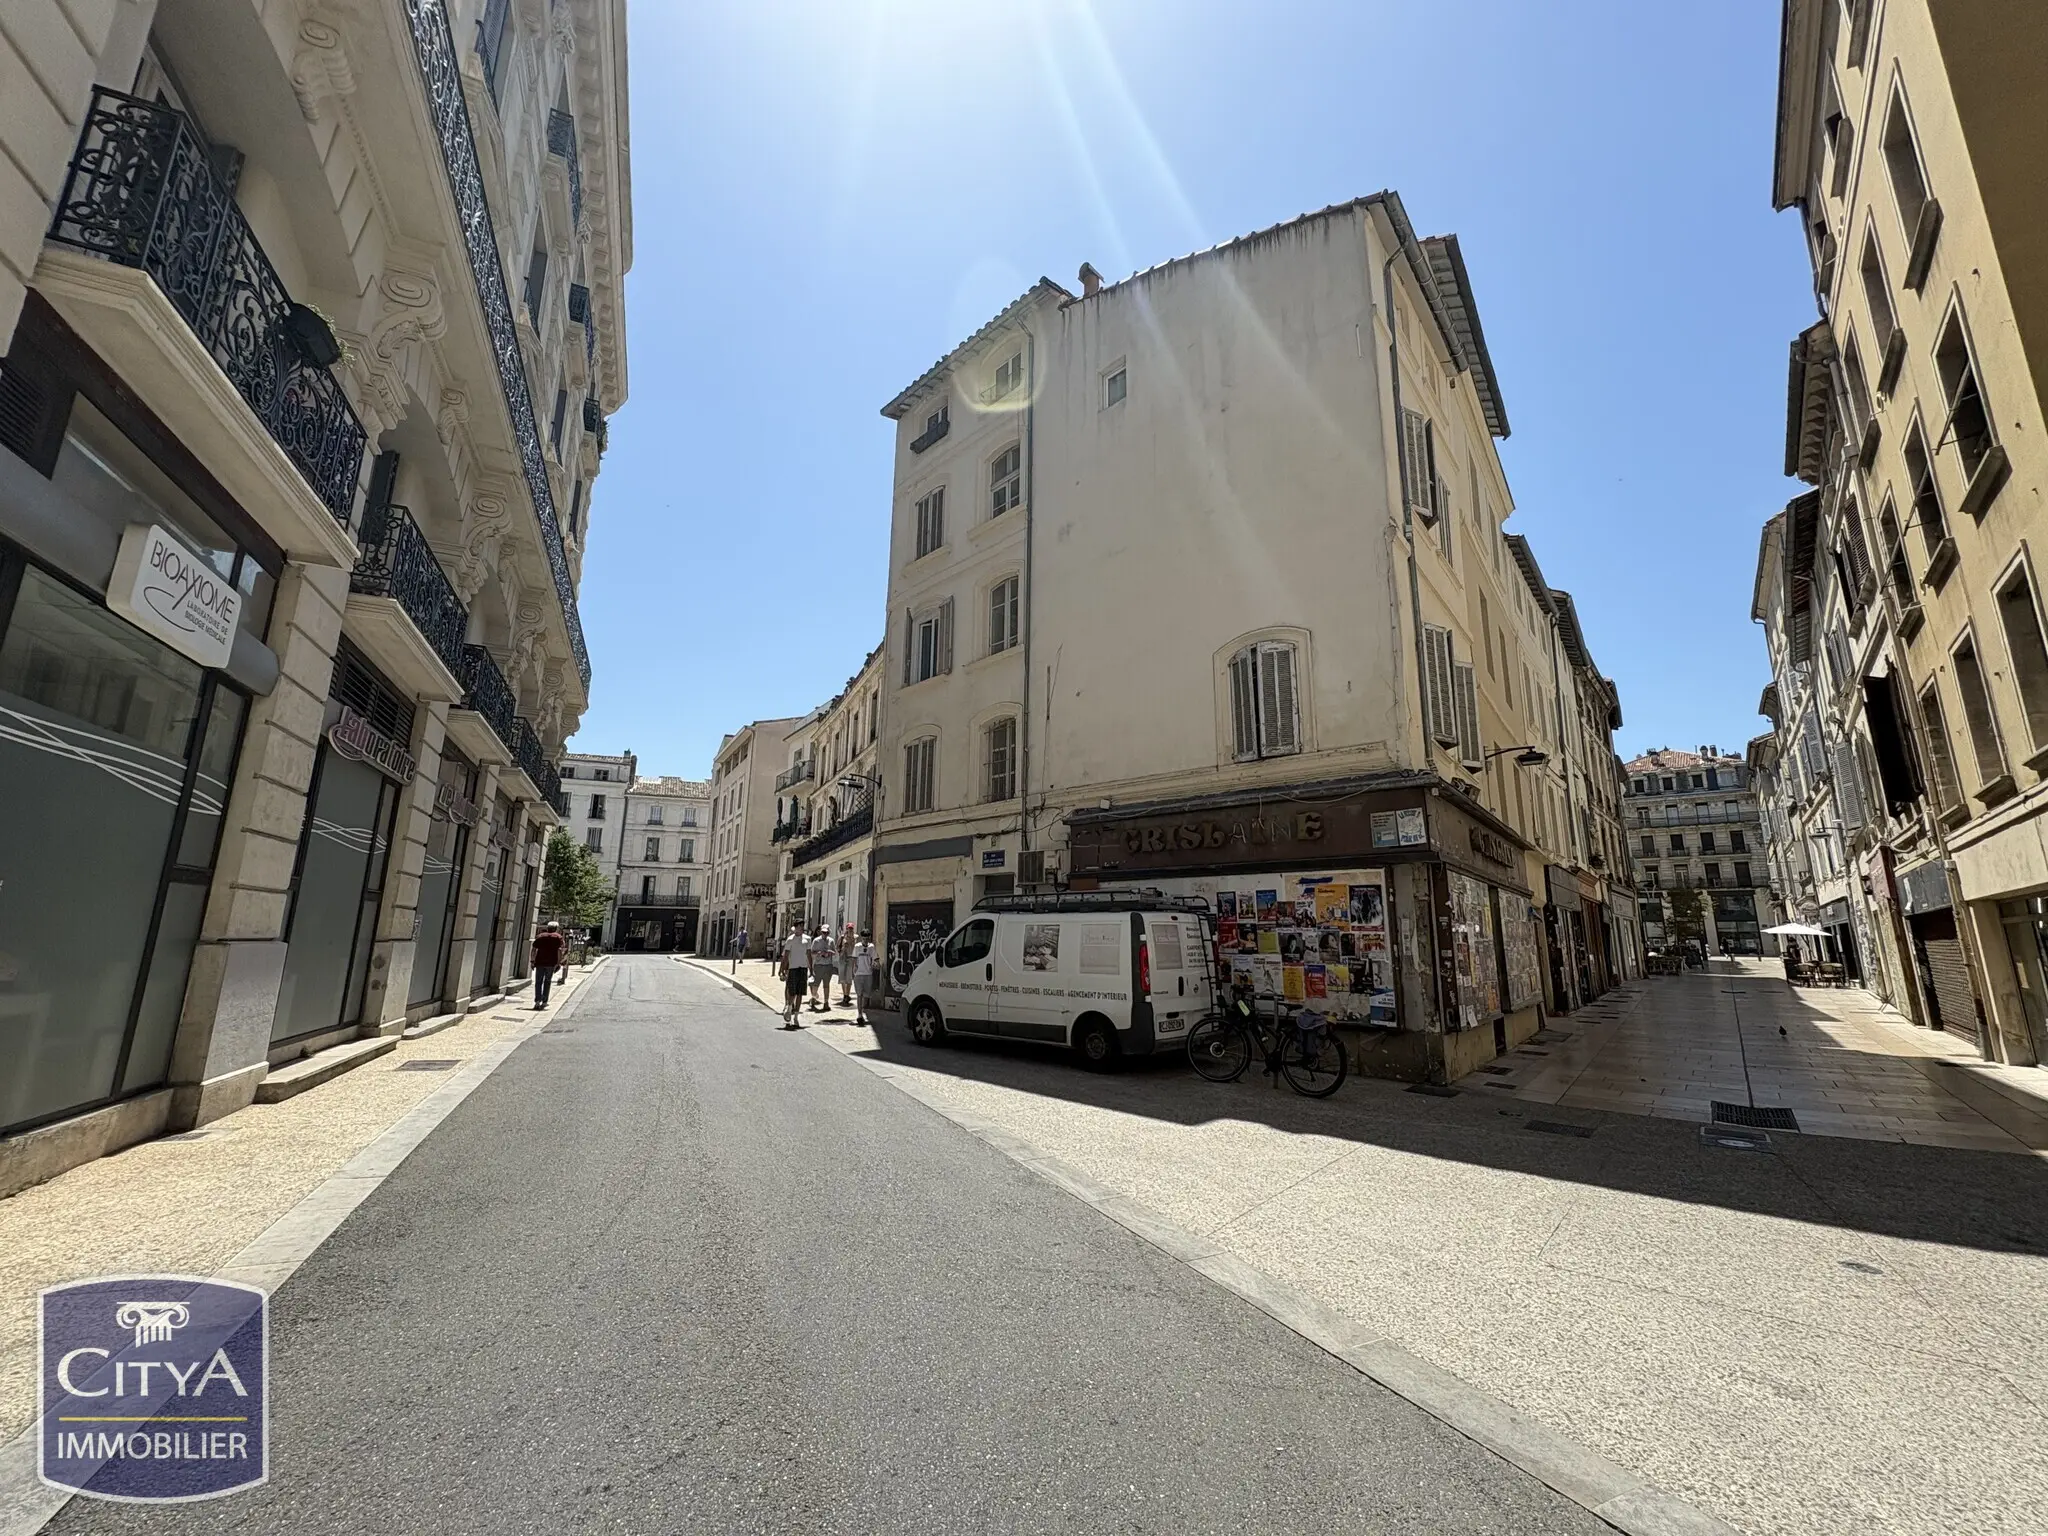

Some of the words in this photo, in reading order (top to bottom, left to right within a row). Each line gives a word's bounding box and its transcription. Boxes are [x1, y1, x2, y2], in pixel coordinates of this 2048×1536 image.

[150, 539, 235, 623] BIOAXIOME
[187, 600, 221, 630] LABORATOIRE
[1068, 989, 1096, 999] AGENCEMENT
